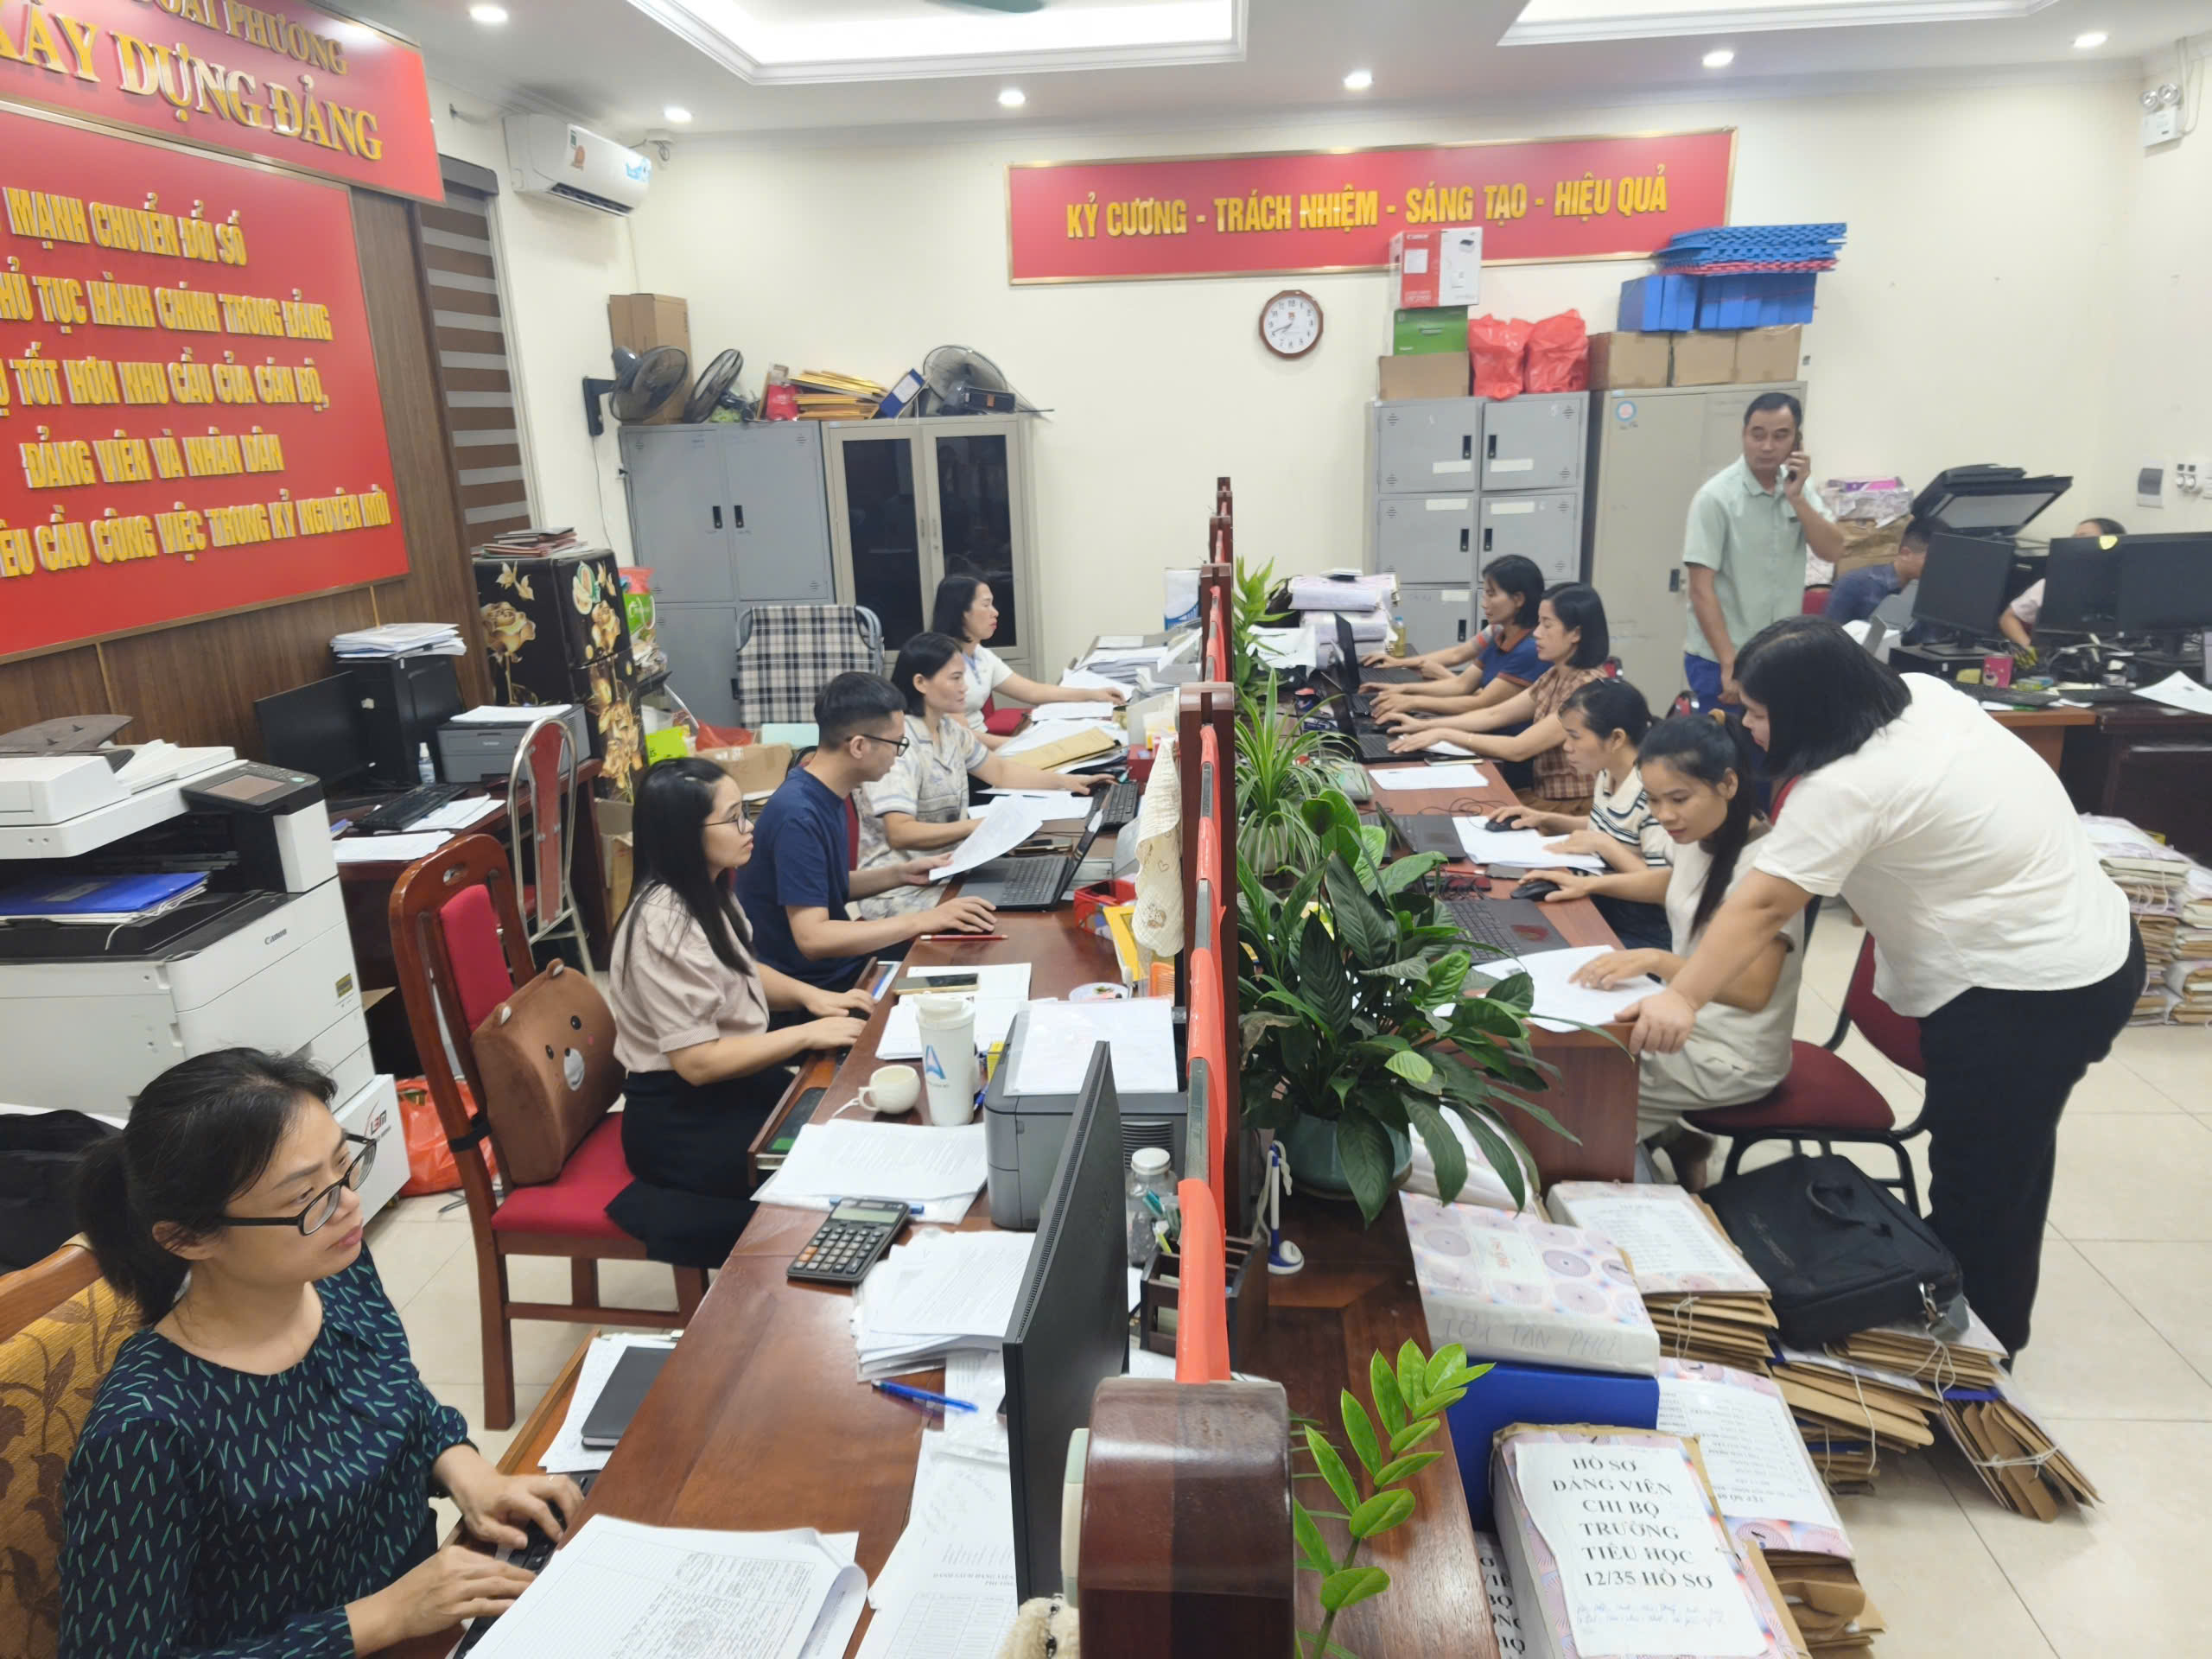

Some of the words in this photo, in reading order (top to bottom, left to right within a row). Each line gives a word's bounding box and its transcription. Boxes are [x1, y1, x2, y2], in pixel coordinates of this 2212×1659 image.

[106, 30, 263, 129] DỰNG
[264, 74, 382, 160] ĐẢNG
[3, 187, 90, 250] MẠNH
[89, 192, 181, 257] CHUYỂN
[177, 200, 219, 263] ĐỔI
[215, 210, 247, 266] SỐ
[1066, 192, 1098, 238] KỶ
[1106, 196, 1187, 236] CƯƠNG
[1214, 188, 1292, 232] TRÁCH
[1300, 183, 1378, 232] NHIỆM
[1406, 181, 1473, 224] SÁNG
[1484, 182, 1527, 227] TẠO
[1554, 172, 1612, 222] HIỆU
[1618, 164, 1667, 217] QUẢ
[32, 276, 87, 334] TỤC
[86, 270, 156, 328] HÀNH
[9, 341, 63, 405] TỐT
[19, 425, 97, 489] ĐẢNG
[92, 429, 152, 483] VIÊN
[149, 428, 186, 479] VÀ
[34, 505, 91, 571] CẦU
[90, 507, 158, 563] CÔNG
[154, 501, 207, 562] VIỆC
[264, 928, 288, 946] Canon
[1582, 1499, 1623, 1514] CHI
[1585, 1569, 1636, 1587] 12/35
